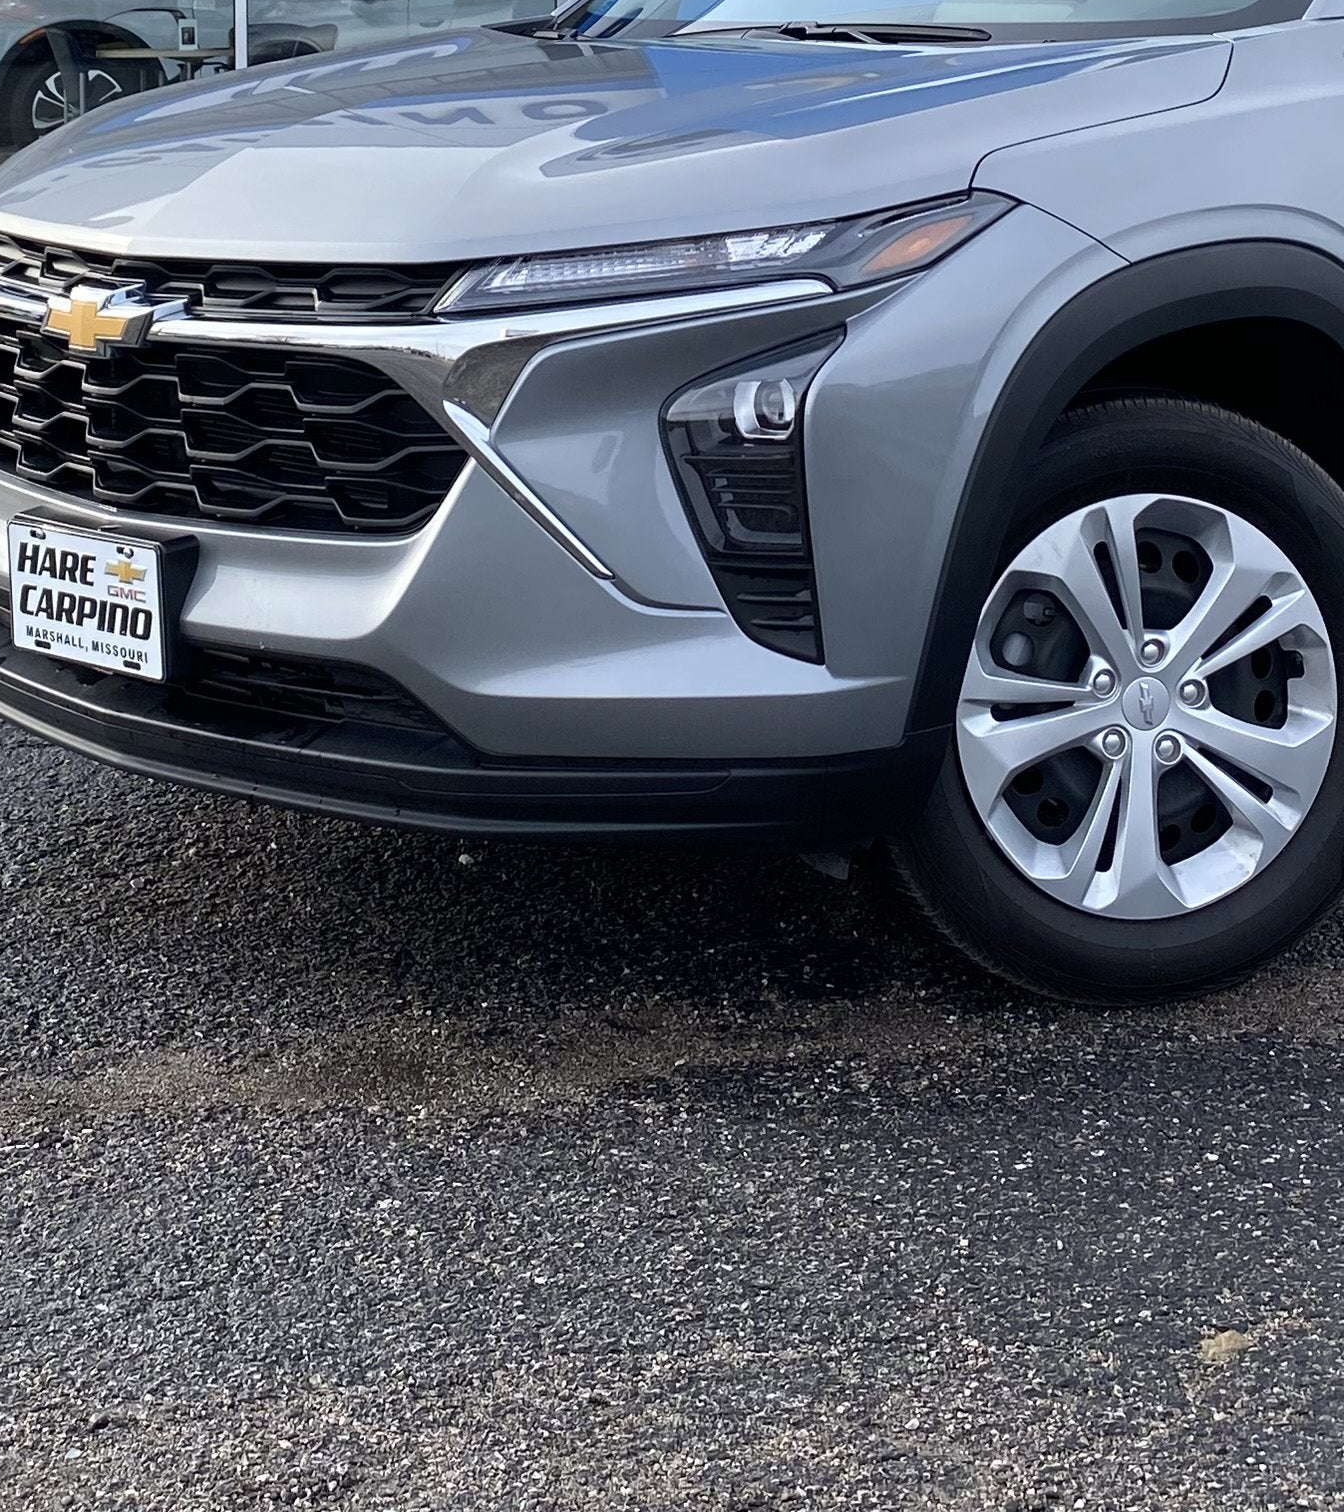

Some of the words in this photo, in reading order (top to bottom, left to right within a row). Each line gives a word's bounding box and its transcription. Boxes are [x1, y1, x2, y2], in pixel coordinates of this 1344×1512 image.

[17, 541, 97, 587] HARE
[19, 584, 153, 641] CARPINO
[106, 584, 147, 604] GMC
[26, 625, 89, 653] MARSHALL,
[91, 639, 148, 664] MISSOURI
